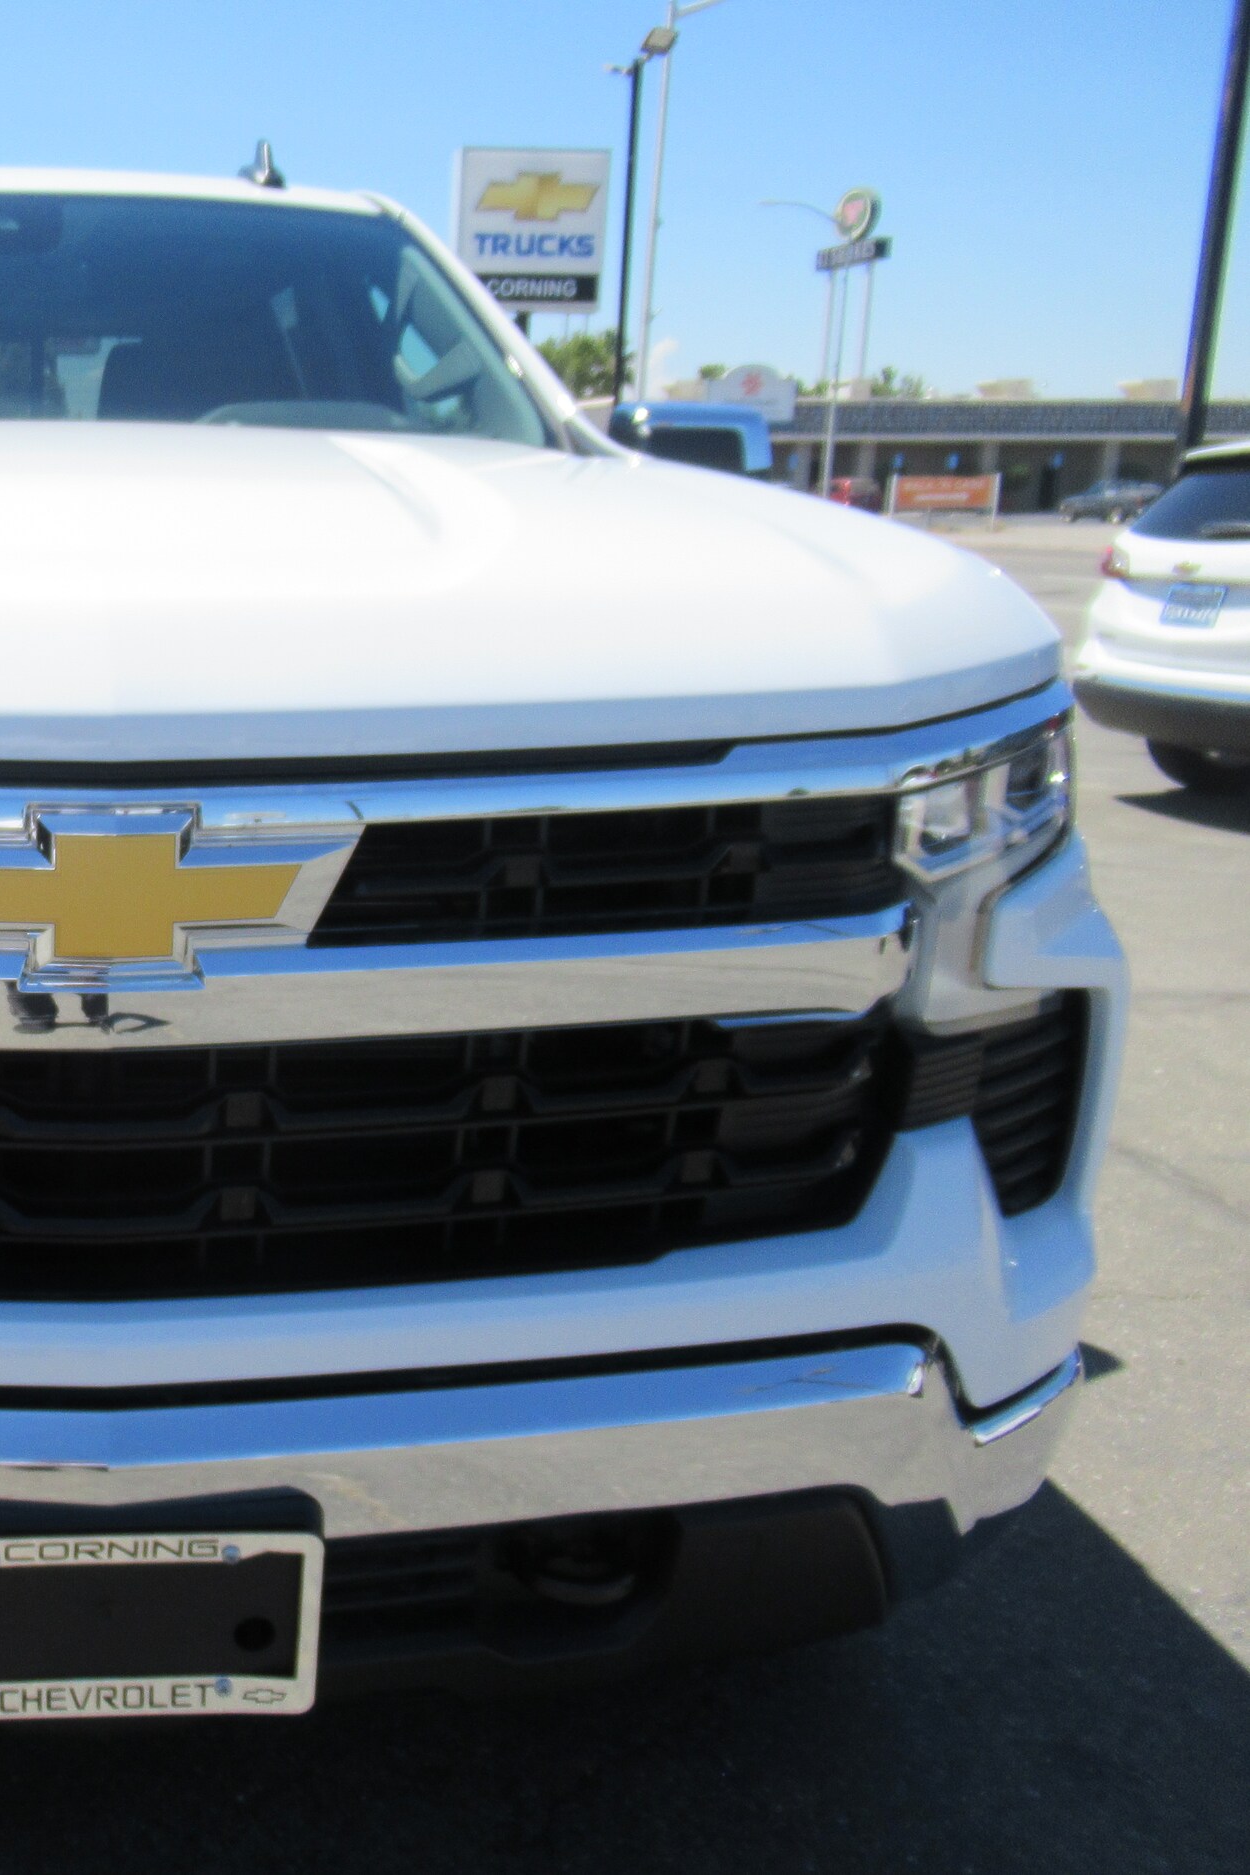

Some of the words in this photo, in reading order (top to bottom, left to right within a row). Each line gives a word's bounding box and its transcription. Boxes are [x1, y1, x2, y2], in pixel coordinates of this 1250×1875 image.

[474, 233, 595, 257] TRUCKS
[486, 277, 578, 297] CORNING
[3, 1539, 220, 1562] CORNING
[0, 1683, 216, 1713] CHEVROLET
